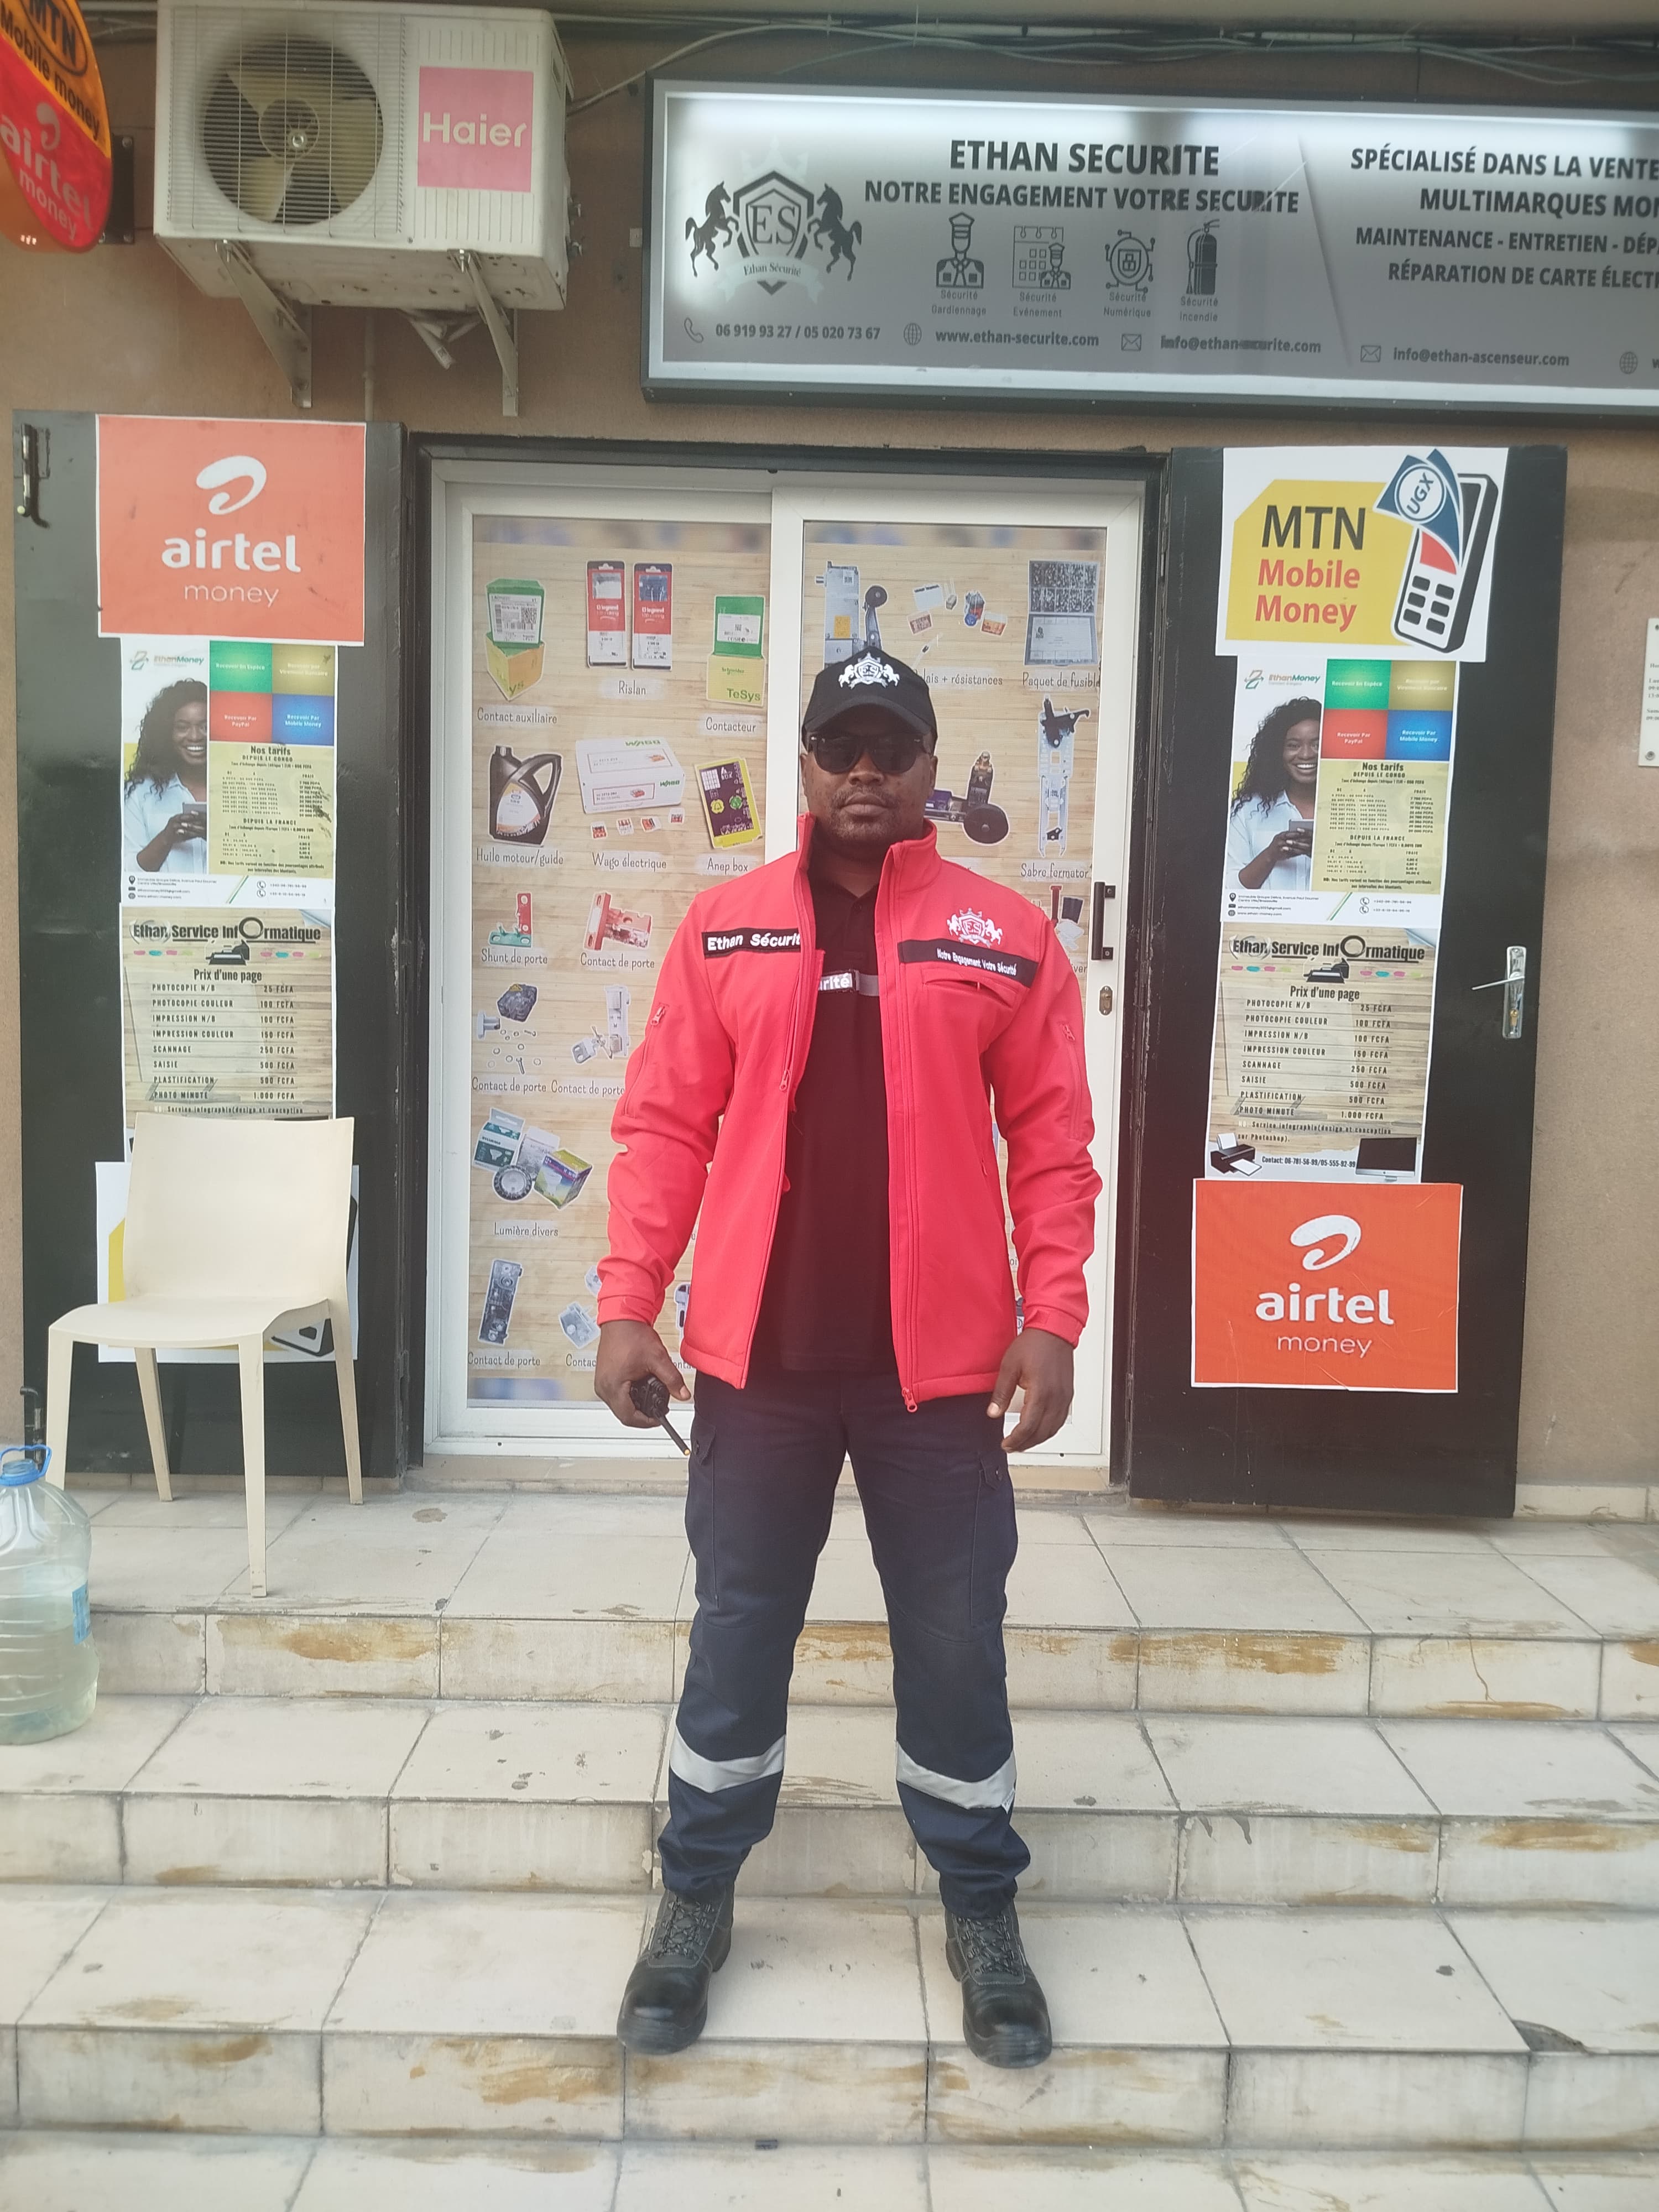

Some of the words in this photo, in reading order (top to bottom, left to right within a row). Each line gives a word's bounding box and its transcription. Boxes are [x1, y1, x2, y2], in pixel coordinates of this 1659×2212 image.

[1, 8, 50, 81] Mobile
[54, 74, 100, 140] money
[422, 112, 527, 149] Haier
[950, 140, 1058, 173] ETHAN
[1068, 144, 1219, 176] SECURITE
[1351, 143, 1476, 173] SPÉCIALISÉ
[1483, 153, 1547, 175] DANS
[1553, 155, 1582, 177] LA
[1589, 156, 1659, 180] VENTE
[0, 114, 93, 231] airtel
[865, 180, 941, 204] NOTRE
[948, 184, 1107, 209] ENGAGEMENT
[1114, 187, 1190, 211] VOTRE
[1196, 190, 1299, 213] SECURITE
[1420, 188, 1606, 219] MULTIMARQUES
[19, 169, 77, 242] money
[750, 205, 797, 244] ES
[1356, 227, 1493, 249] MAINTENANCE
[1509, 232, 1608, 253] ENTRETIEN
[743, 263, 768, 276] Ethan
[769, 262, 801, 277] Sécurité
[1389, 259, 1506, 284] RÉPARATION
[1511, 267, 1533, 285] DE
[1539, 268, 1596, 287] CARTE
[940, 289, 978, 301] Sécurité
[1019, 291, 1056, 303] Sécurité
[1109, 290, 1146, 303] Sécurité
[1181, 295, 1218, 307] Sécurité
[932, 305, 987, 317] Gardiennage
[1013, 307, 1062, 319] Evénement
[1104, 307, 1151, 319] Numérique
[716, 324, 731, 337] 06
[733, 325, 755, 338] 919
[759, 325, 774, 338] 93
[777, 325, 792, 338] 27
[805, 326, 818, 339] 05
[822, 326, 844, 340] 020
[847, 327, 862, 340] 73
[865, 327, 880, 340] 67
[936, 330, 1099, 347] www.ethan-securite.com
[1394, 347, 1569, 367] info@ethan-ascenseur.com
[1407, 472, 1433, 514] UGX
[1262, 504, 1365, 550] MTN
[161, 528, 301, 572] airtel
[1258, 559, 1360, 588] Mobile
[185, 585, 279, 607] money
[1255, 595, 1357, 632] Money
[860, 665, 878, 675] ES
[951, 674, 1003, 685] résistances
[1022, 672, 1054, 691] Paquet
[1057, 671, 1067, 687] de
[618, 680, 646, 696] Rislan
[727, 688, 761, 702] TeSys
[477, 707, 513, 723] Contact
[516, 709, 557, 724] auxiliaire
[706, 718, 756, 733] Contacteur
[1363, 763, 1377, 771] Nos
[1381, 763, 1404, 771] tarifs
[476, 848, 500, 863] Huile
[503, 849, 564, 867] moteur/guide
[592, 852, 619, 869] Wago
[622, 852, 667, 870] électrique
[707, 857, 731, 873] Anep
[733, 858, 748, 872] box
[1021, 863, 1046, 878] Sabre
[1050, 863, 1089, 878] fermator
[133, 925, 169, 938] Ethan
[172, 925, 218, 938] Service
[965, 922, 981, 934] ES
[707, 935, 743, 951] Ethan
[750, 932, 801, 947] Sécurit
[1233, 940, 1268, 954] Ethan
[1272, 941, 1319, 956] Service
[481, 948, 508, 963] Shunt
[510, 950, 521, 963] de
[524, 952, 547, 966] porte
[580, 952, 616, 967] Contact
[618, 953, 629, 967] de
[632, 956, 655, 971] porte
[937, 947, 951, 961] Notre
[952, 952, 982, 967] Engagement
[982, 959, 996, 972] Votre
[997, 961, 1017, 975] Sécurité
[194, 969, 211, 980] Prix
[215, 970, 238, 981] d'une
[241, 972, 262, 983] page
[1290, 985, 1307, 998] Prix
[1311, 986, 1335, 999] d'une
[1338, 989, 1360, 1001] page
[1247, 999, 1292, 1009] PHOTOCOPIE
[1296, 1001, 1311, 1009] N/B
[1360, 1004, 1370, 1012] 25
[1246, 1015, 1291, 1024] PHOTOCOPIE
[1295, 1016, 1328, 1025] COULEUR
[1245, 1030, 1290, 1039] IMPRESSION
[1294, 1031, 1308, 1040] N/B
[1371, 1035, 1390, 1044] FCFA
[1244, 1045, 1289, 1055] IMPRESSION
[1293, 1047, 1326, 1056] COULEUR
[1354, 1050, 1366, 1058] 150
[1243, 1061, 1281, 1070] SCANNAGE
[1351, 1066, 1365, 1074] 250
[1369, 1066, 1387, 1074] FCFA
[472, 1077, 508, 1091] Contact
[510, 1078, 520, 1092] de
[523, 1081, 546, 1095] porte
[551, 1079, 586, 1094] Contact
[588, 1081, 599, 1094] de
[1241, 1076, 1266, 1084] SAISIE
[1368, 1082, 1386, 1090] FCFA
[1240, 1091, 1302, 1101] PLASTIFICATION
[1349, 1096, 1363, 1104] 500
[1366, 1097, 1385, 1105] FCFA
[1266, 1108, 1295, 1116] MINUTE
[1341, 1111, 1362, 1119] 1.000
[1365, 1112, 1384, 1120] FCFA
[1262, 1156, 1283, 1164] Contact:
[494, 1222, 529, 1237] Lumière
[531, 1222, 559, 1237] divers
[1255, 1283, 1394, 1325] airtel
[1277, 1335, 1373, 1358] money
[467, 1352, 502, 1365] Contact
[504, 1353, 515, 1366] de
[517, 1354, 540, 1367] porte
